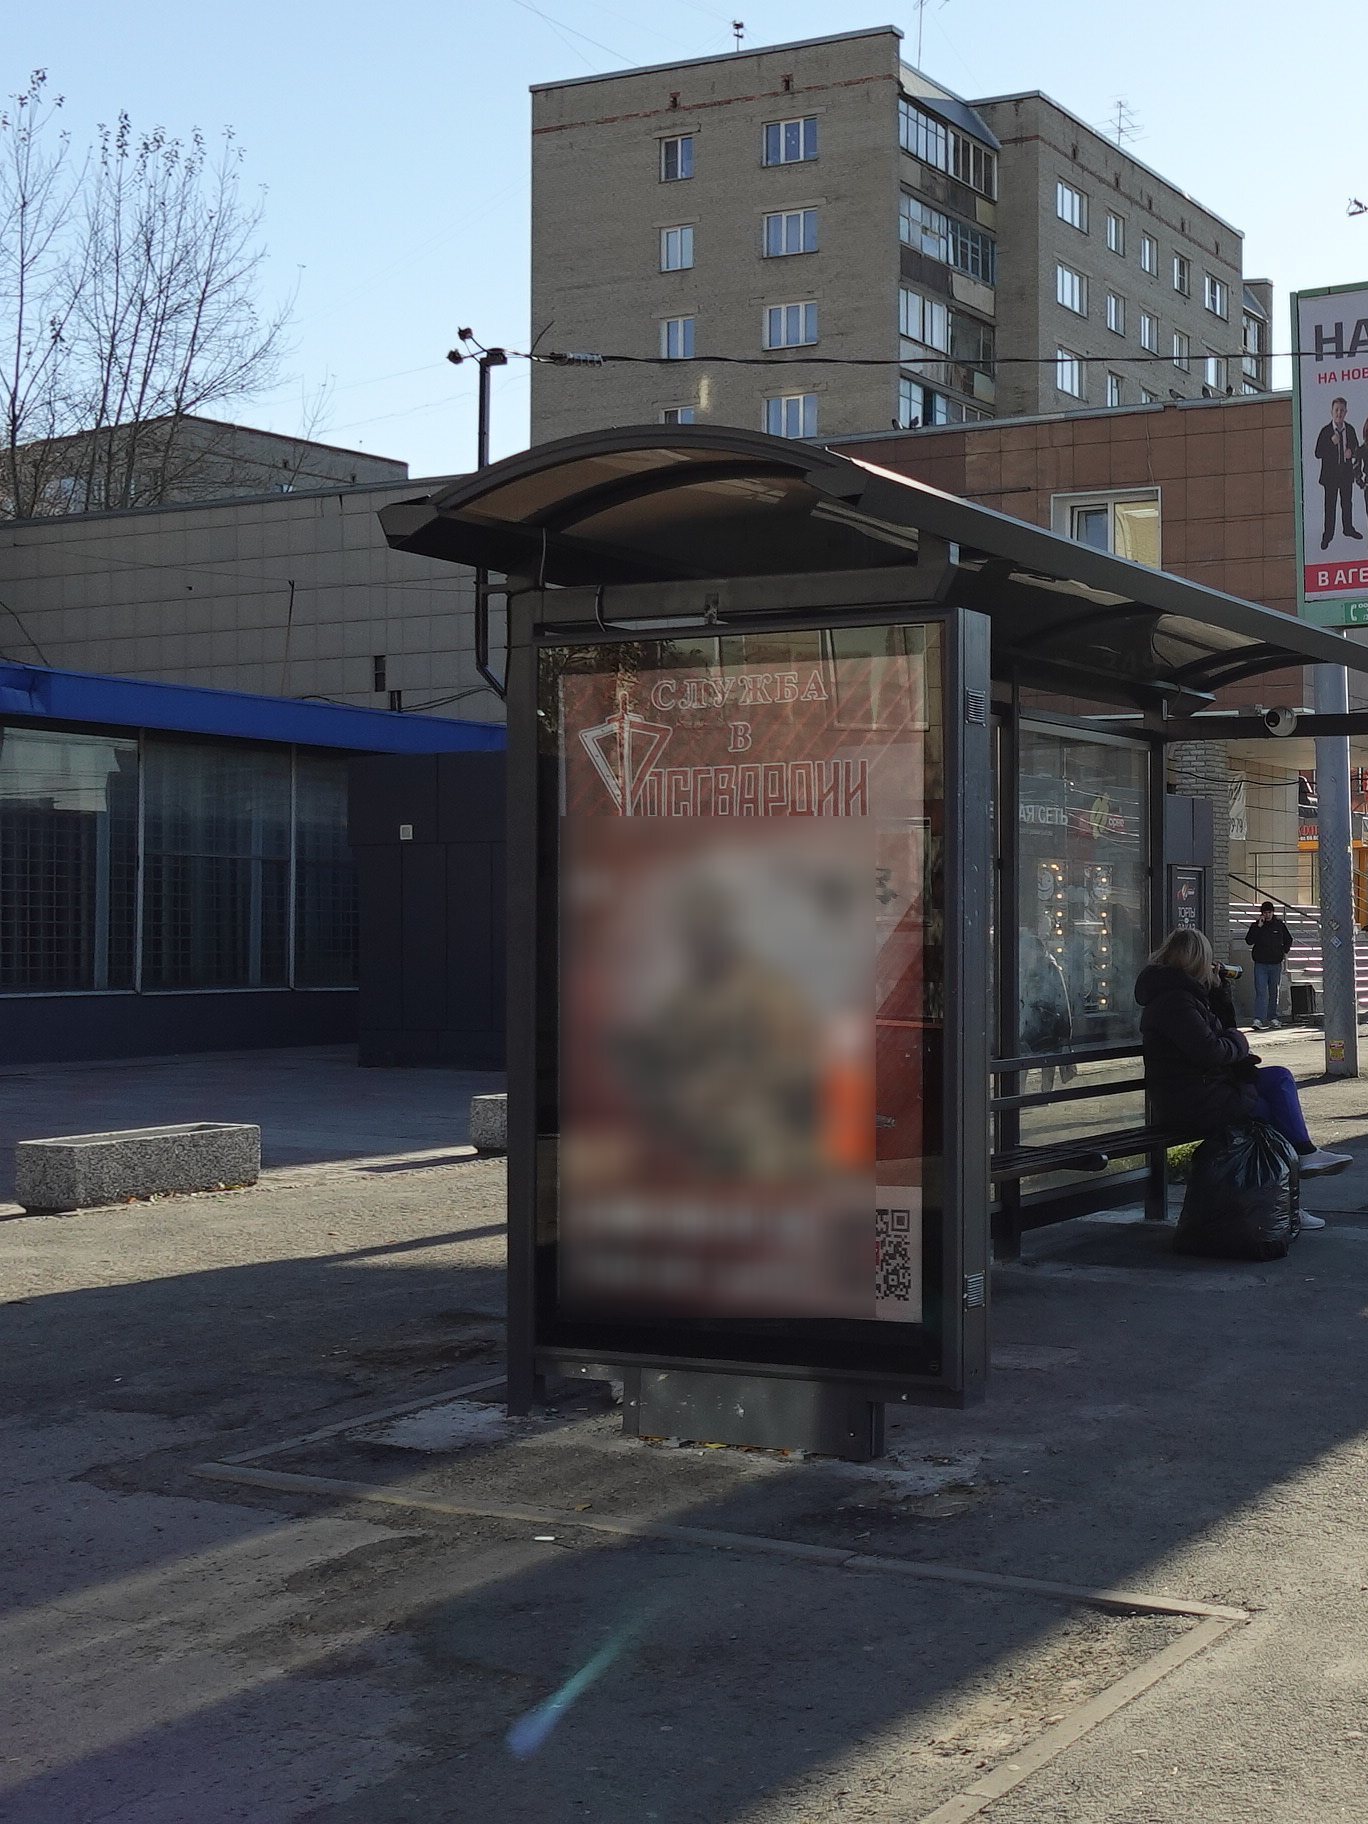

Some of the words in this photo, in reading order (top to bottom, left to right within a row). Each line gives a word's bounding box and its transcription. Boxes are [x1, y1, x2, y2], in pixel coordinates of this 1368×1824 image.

[1317, 371, 1338, 385] НА
[1317, 570, 1330, 587] В
[650, 670, 829, 712] СЛУЖБА
[728, 721, 752, 753] В
[1039, 806, 1069, 826] СЕТЬ
